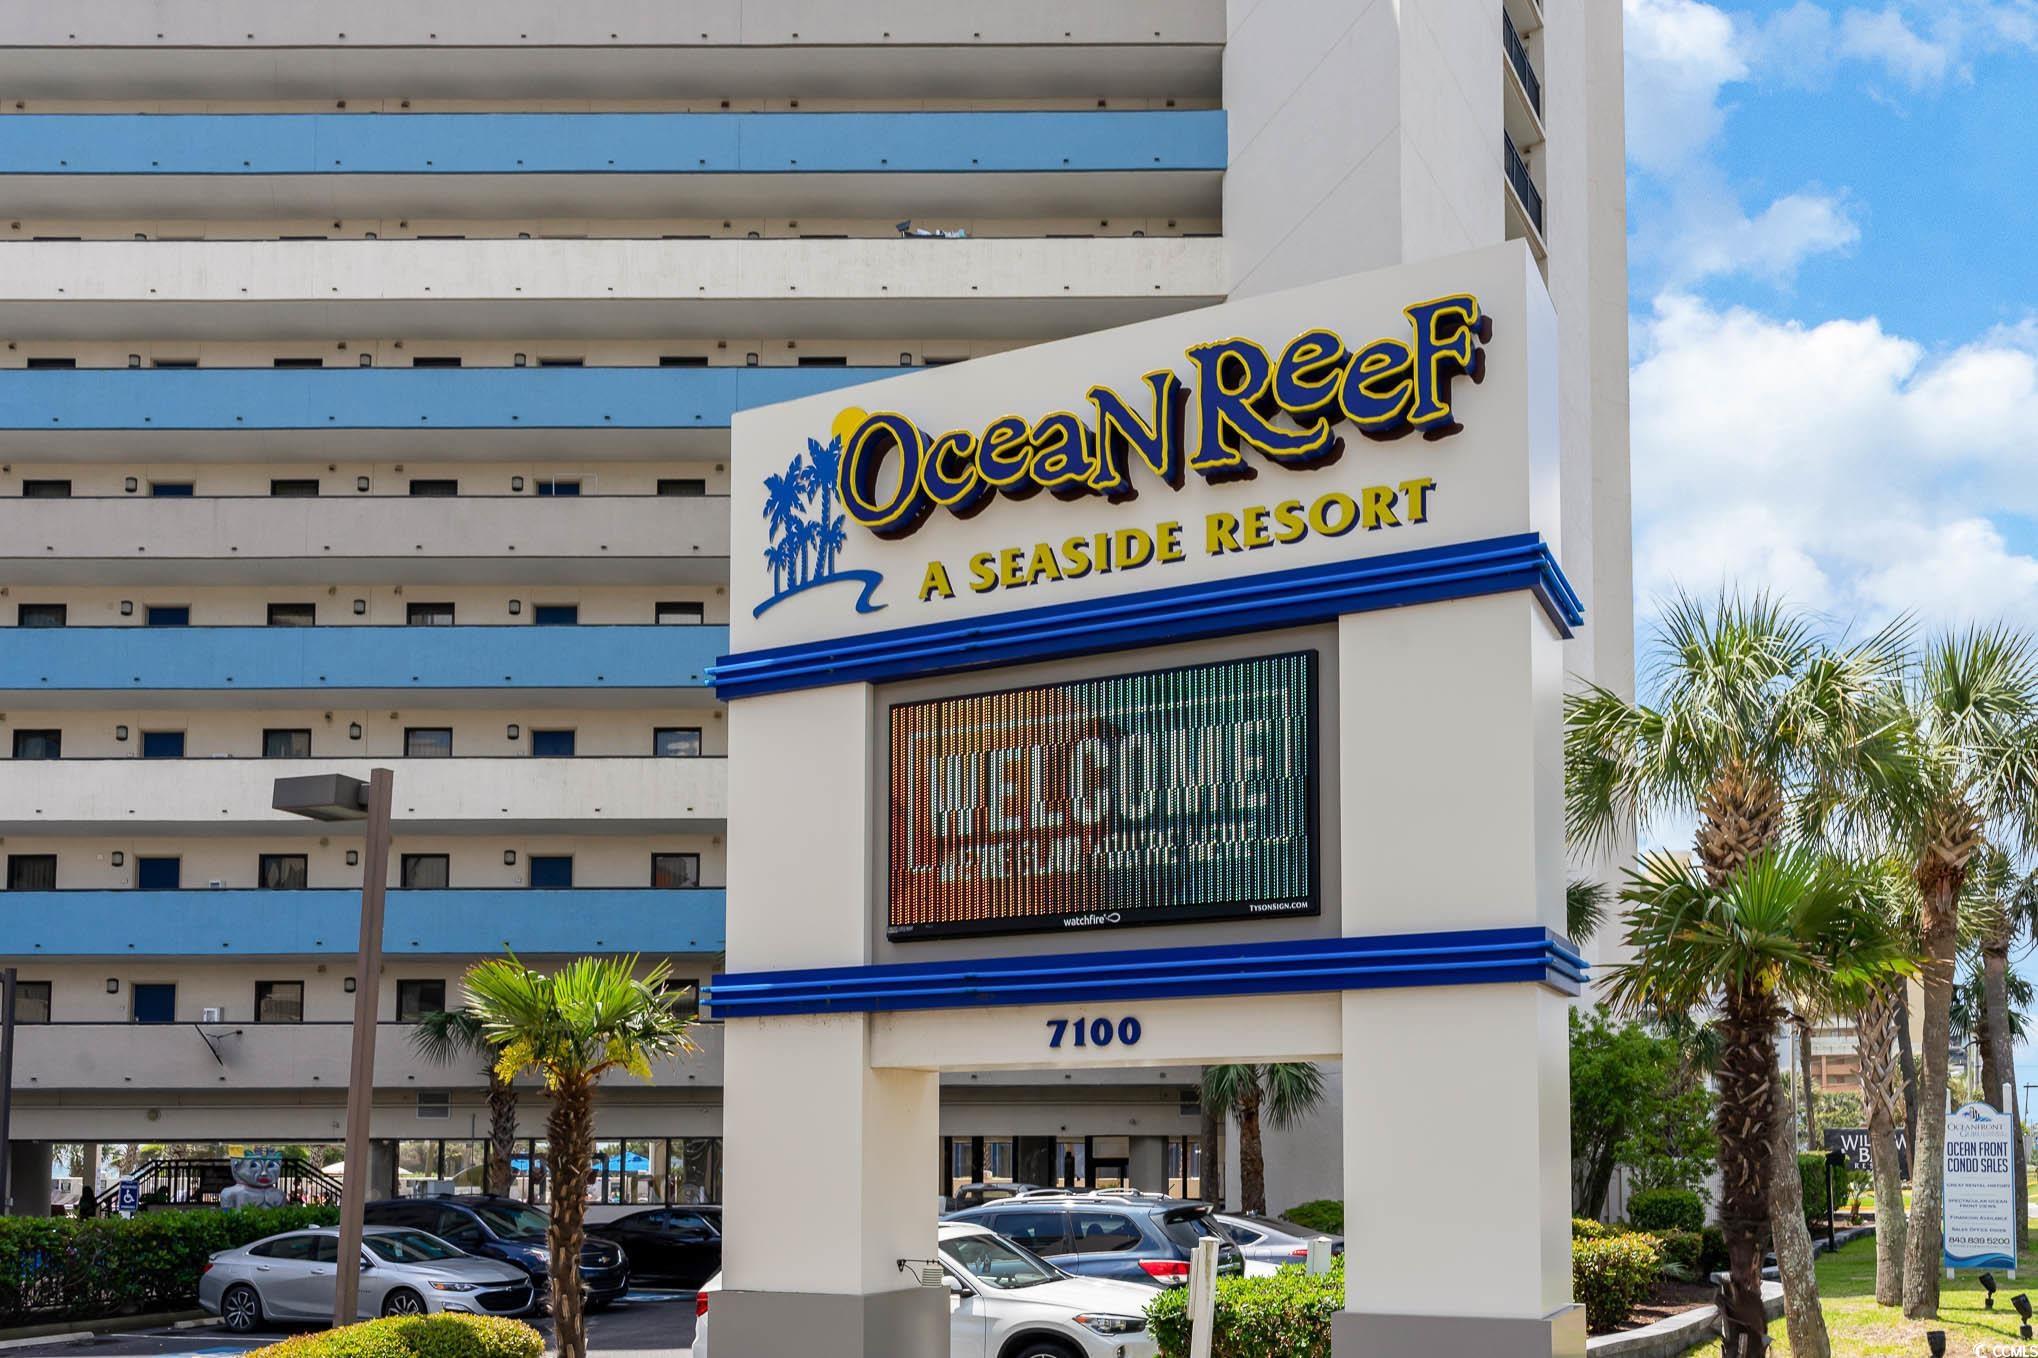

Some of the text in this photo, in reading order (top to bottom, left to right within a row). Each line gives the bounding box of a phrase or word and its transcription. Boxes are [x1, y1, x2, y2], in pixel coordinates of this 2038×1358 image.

[918, 477, 1436, 602] A SEASIDE RESORT
[929, 719, 1271, 838] WELCOME
[1249, 901, 1308, 912] TYSONSIGN.COM
[1063, 914, 1105, 927] watchfire
[1046, 1016, 1142, 1048] 7100
[1947, 1142, 2008, 1157] OCEAN FRONT
[1947, 1158, 2009, 1173] CONDO SALES
